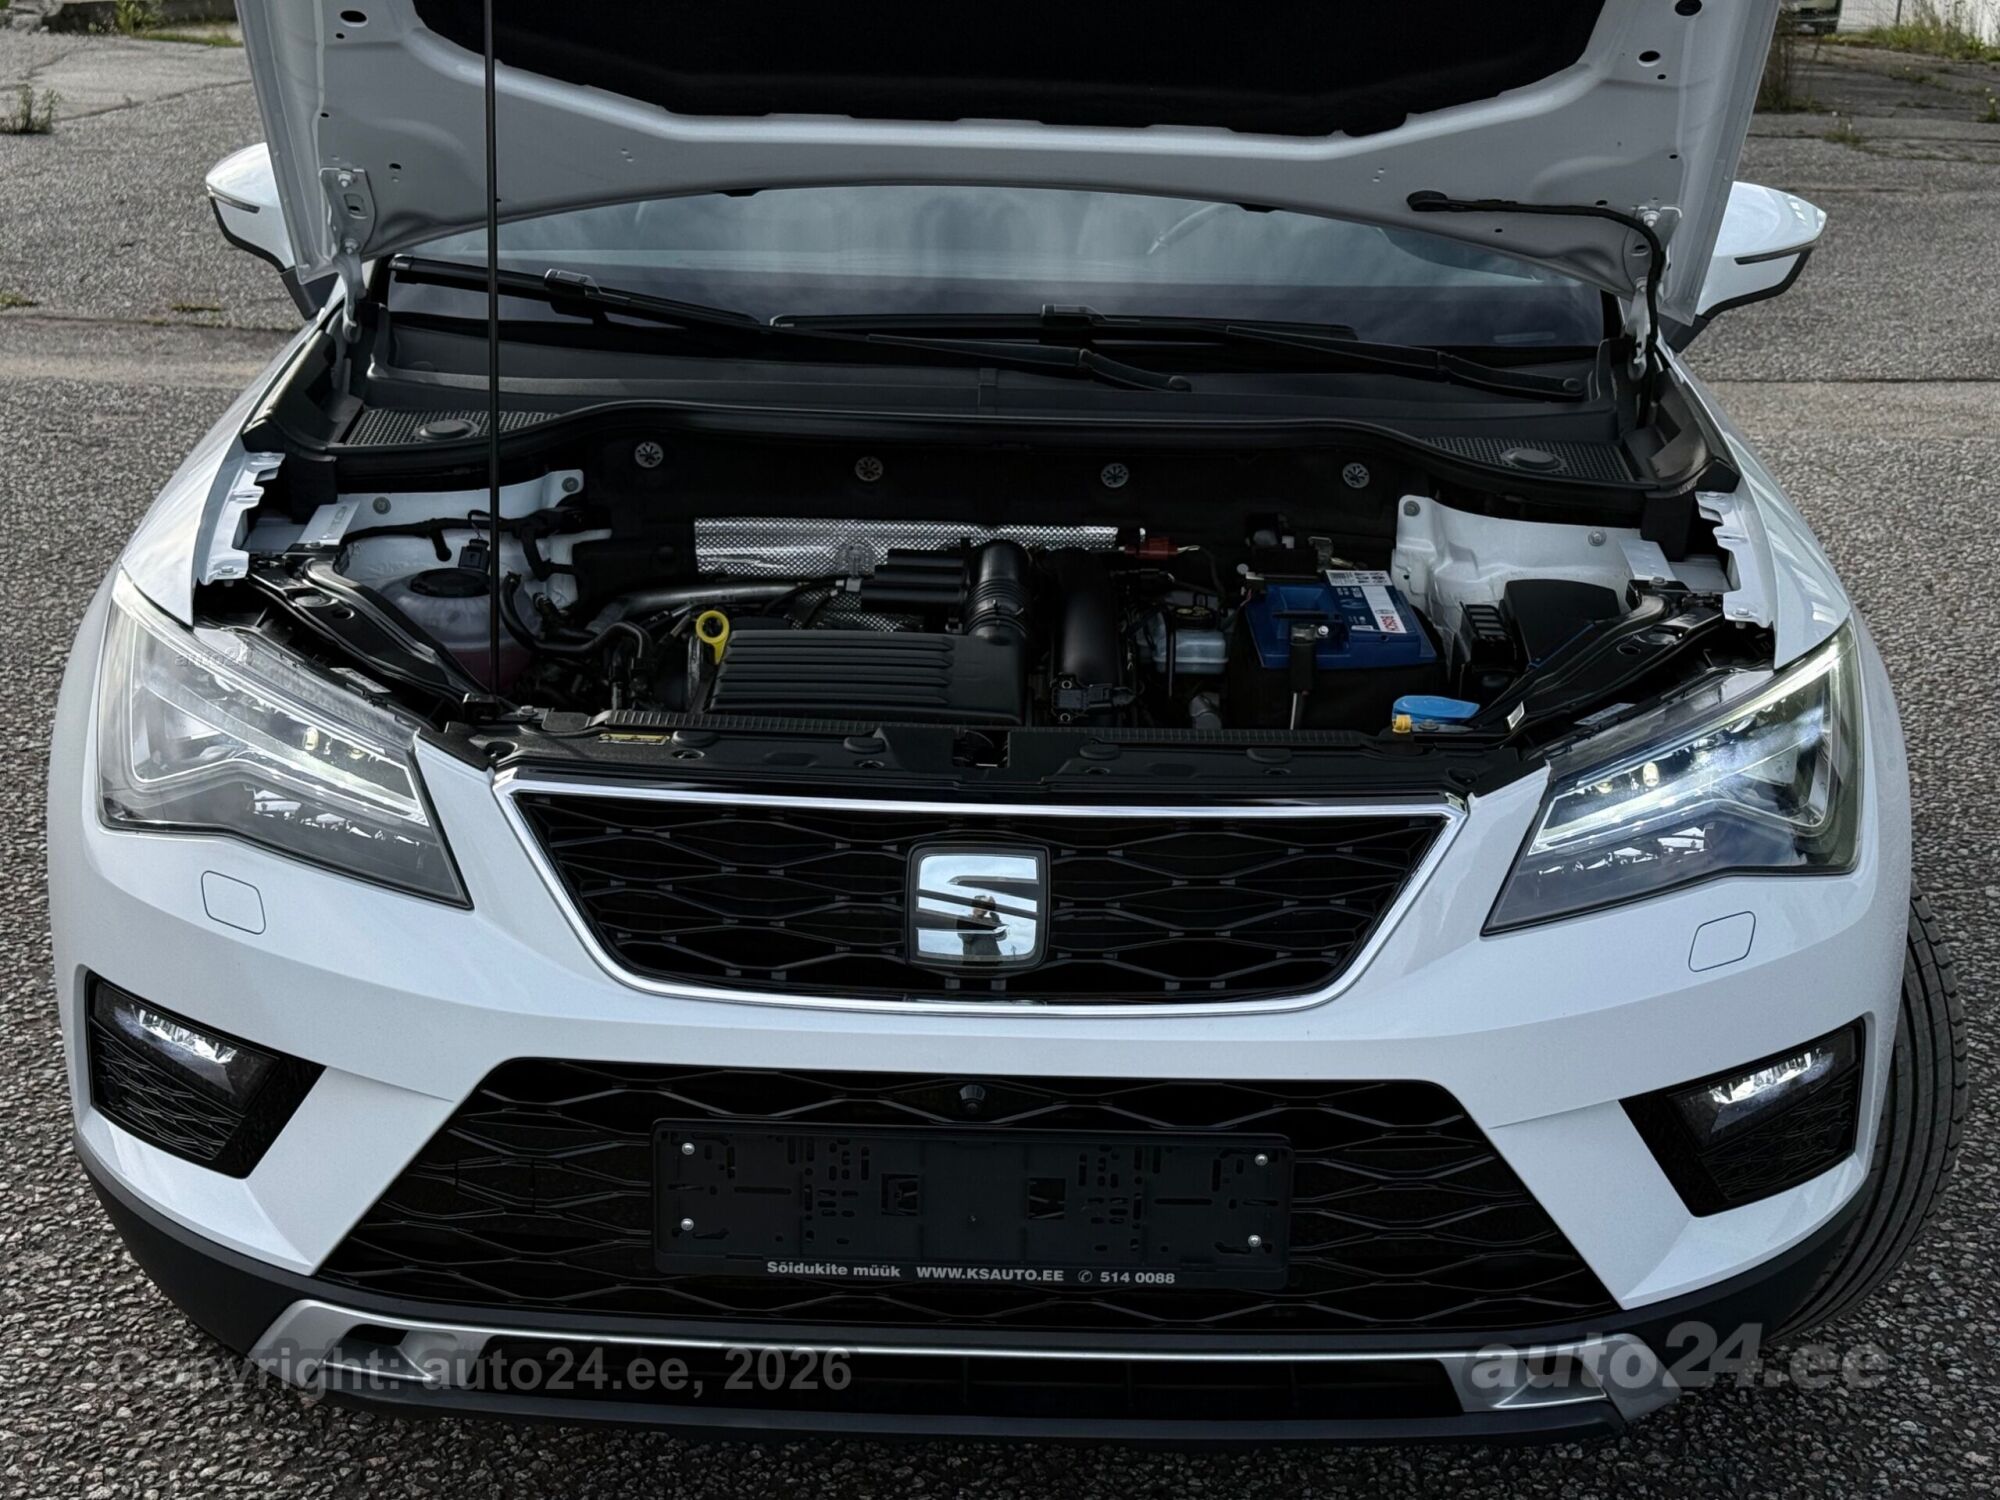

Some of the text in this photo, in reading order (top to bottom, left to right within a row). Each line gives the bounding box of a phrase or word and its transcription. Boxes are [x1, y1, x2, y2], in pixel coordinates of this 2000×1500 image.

[767, 1261, 1176, 1284] Sõidukite müük WWW.KSAUTO.EE 514 0088
